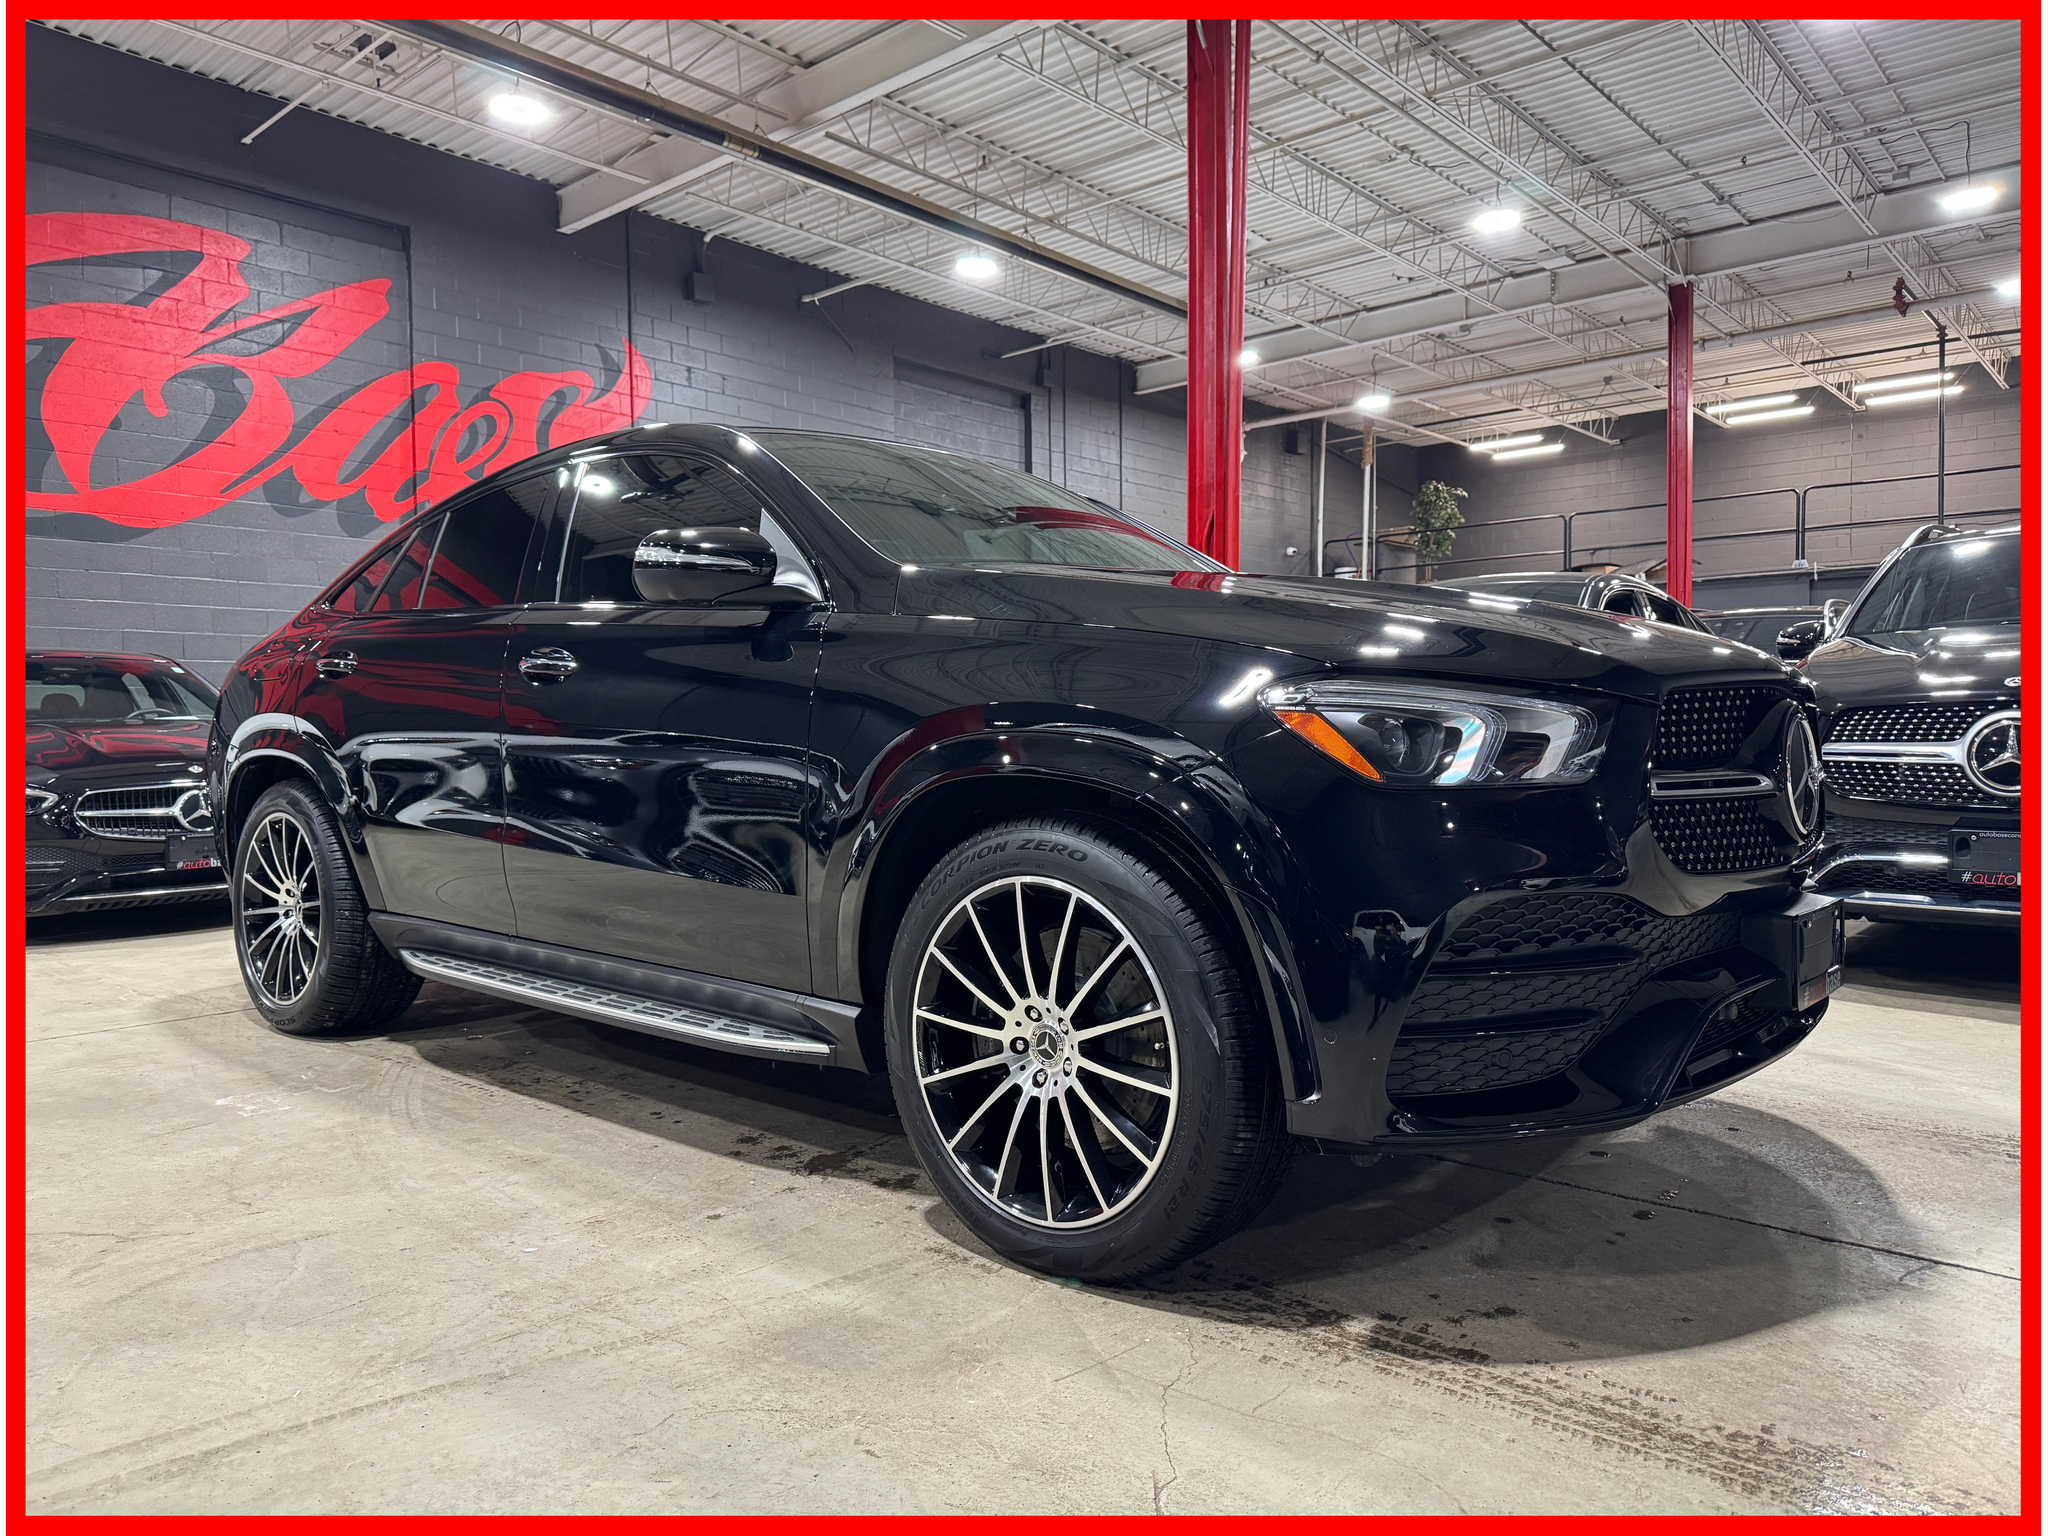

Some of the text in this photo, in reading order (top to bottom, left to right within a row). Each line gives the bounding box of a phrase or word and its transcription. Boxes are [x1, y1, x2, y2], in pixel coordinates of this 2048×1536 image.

[913, 838, 1089, 927] SCORPION ZERO
[1163, 1176, 1191, 1221] R21
